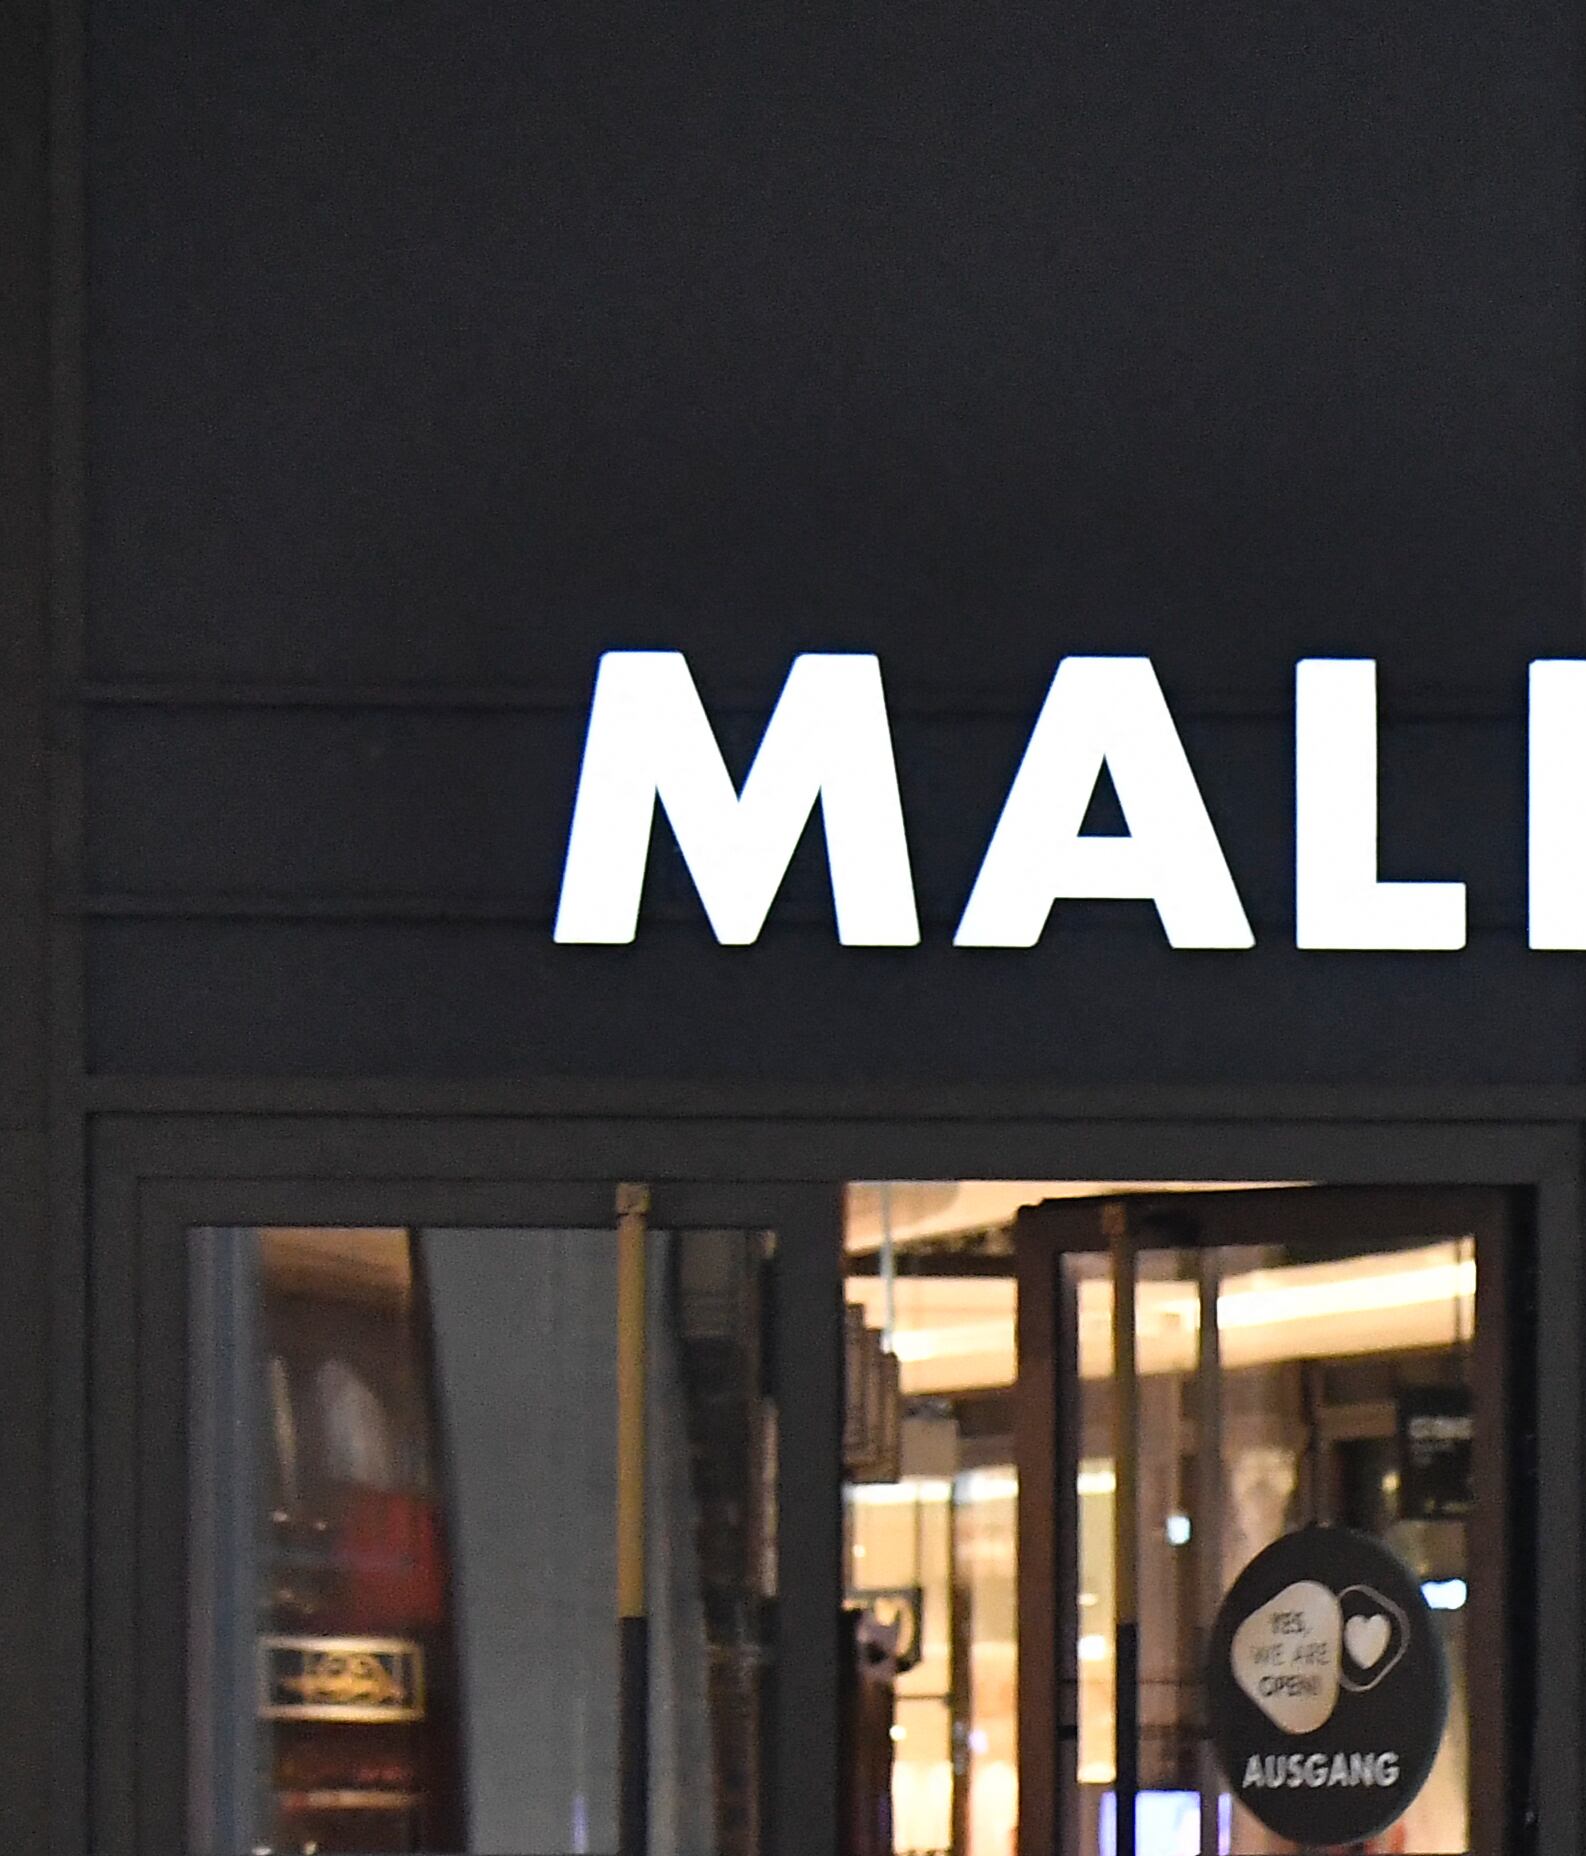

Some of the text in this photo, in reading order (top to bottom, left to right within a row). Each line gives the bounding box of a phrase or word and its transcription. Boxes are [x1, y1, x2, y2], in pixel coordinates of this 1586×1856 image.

[1271, 1612, 1311, 1637] YES,
[1252, 1643, 1330, 1666] WE ARE
[1242, 1751, 1401, 1789] AUSGANG
